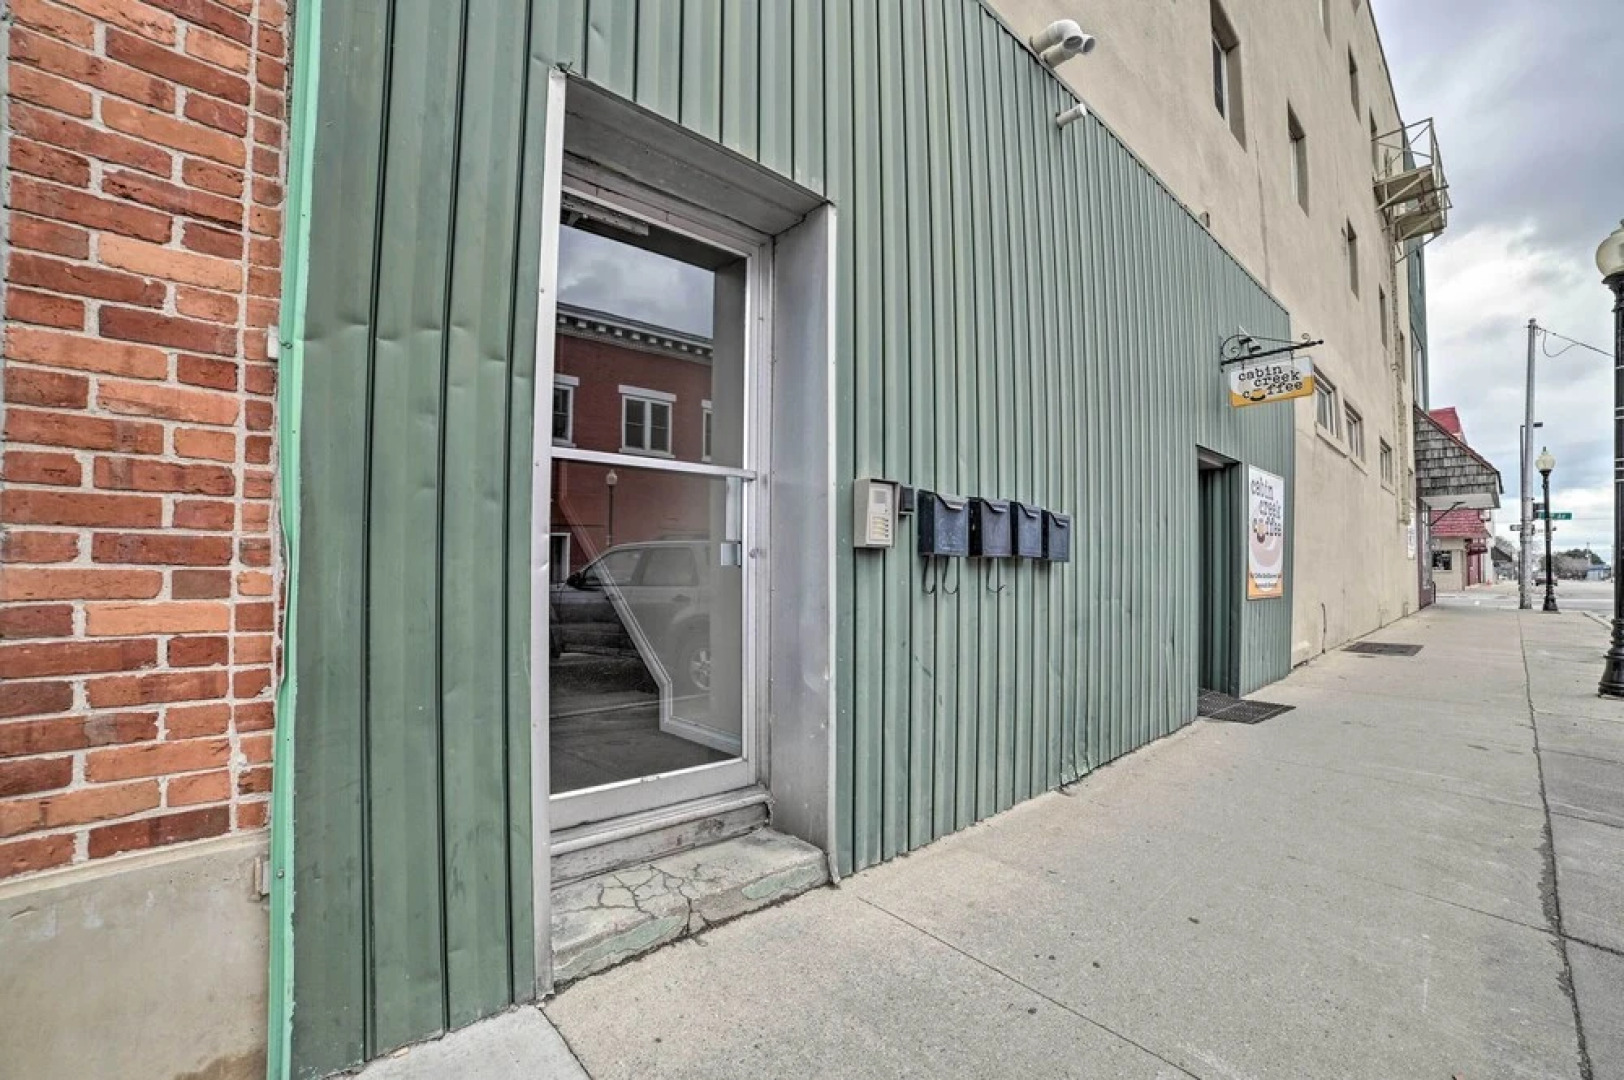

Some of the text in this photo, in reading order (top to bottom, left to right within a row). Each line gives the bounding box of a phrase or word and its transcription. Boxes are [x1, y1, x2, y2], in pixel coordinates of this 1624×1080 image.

[1238, 365, 1283, 382] cabin
[1253, 370, 1300, 387] creek
[1250, 477, 1274, 500] cabin
[1259, 499, 1282, 519] creek
